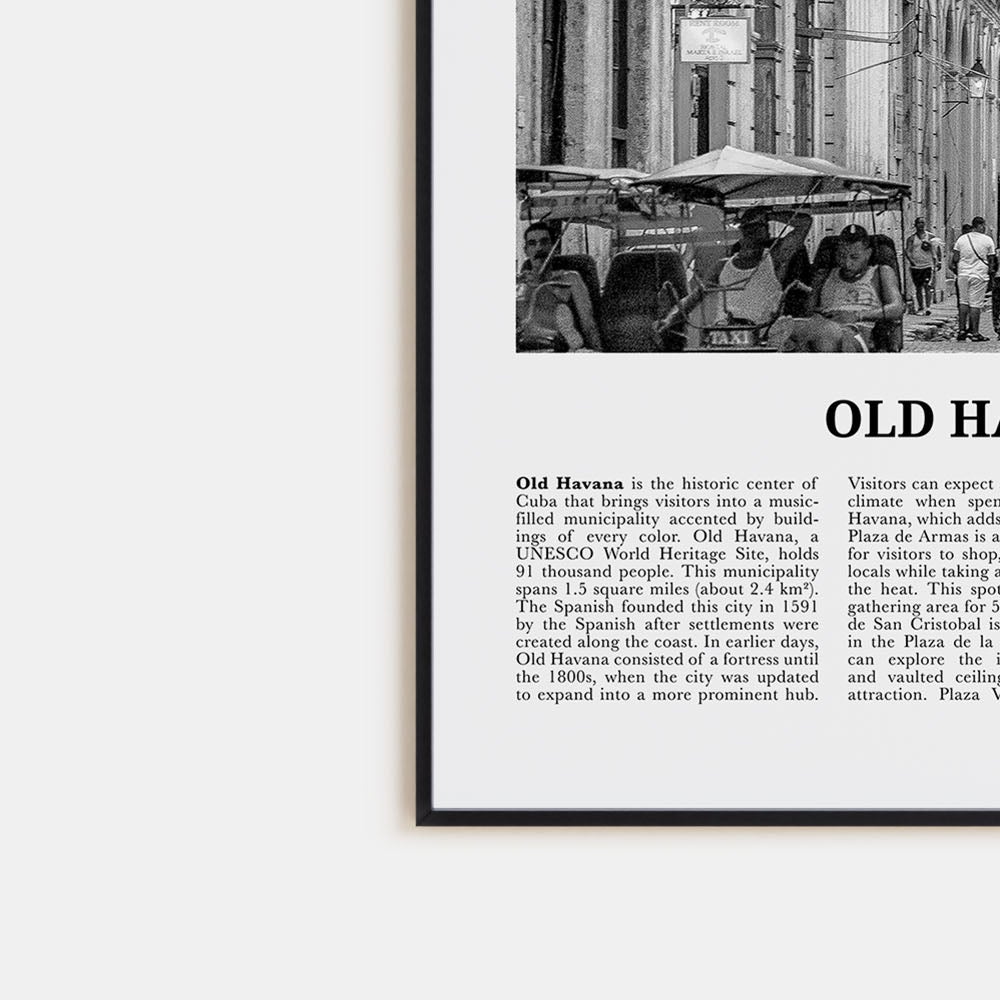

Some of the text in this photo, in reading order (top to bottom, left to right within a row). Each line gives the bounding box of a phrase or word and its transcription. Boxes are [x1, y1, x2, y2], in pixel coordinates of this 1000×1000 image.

[709, 330, 749, 344] TAXI
[826, 399, 934, 438] OLD
[516, 476, 818, 490] Old Havana is the historic center of
[848, 476, 906, 490] Visitors
[912, 481, 938, 490] can
[945, 480, 993, 494] expect
[516, 494, 819, 511] Cuba that brings visitors into a music-
[848, 512, 912, 528] Havana,
[917, 512, 961, 525] which
[967, 512, 1000, 525] adds
[516, 547, 819, 564] UNESCO World Heritage Site, holds
[848, 547, 870, 560] for
[877, 547, 931, 560] visitors
[940, 550, 954, 560] to
[516, 582, 818, 599] spans 1.5 square miles (about 2.4 km²).
[848, 582, 871, 595] the
[881, 582, 917, 595] heat.
[929, 582, 962, 595] This
[516, 617, 818, 634] by the Spanish after settlements were
[848, 617, 865, 630] de
[874, 617, 901, 630] San
[911, 617, 980, 630] Cristobal
[989, 617, 1000, 630] is
[848, 635, 862, 647] in
[872, 635, 894, 648] the
[904, 635, 944, 648] Plaza
[954, 635, 971, 648] de
[980, 635, 993, 648] la
[516, 652, 818, 665] Old Havana consisted of a fortress until
[516, 687, 818, 704] to expand into a more prominent hub.
[848, 687, 926, 701] attraction.
[940, 687, 980, 700] Plaza
